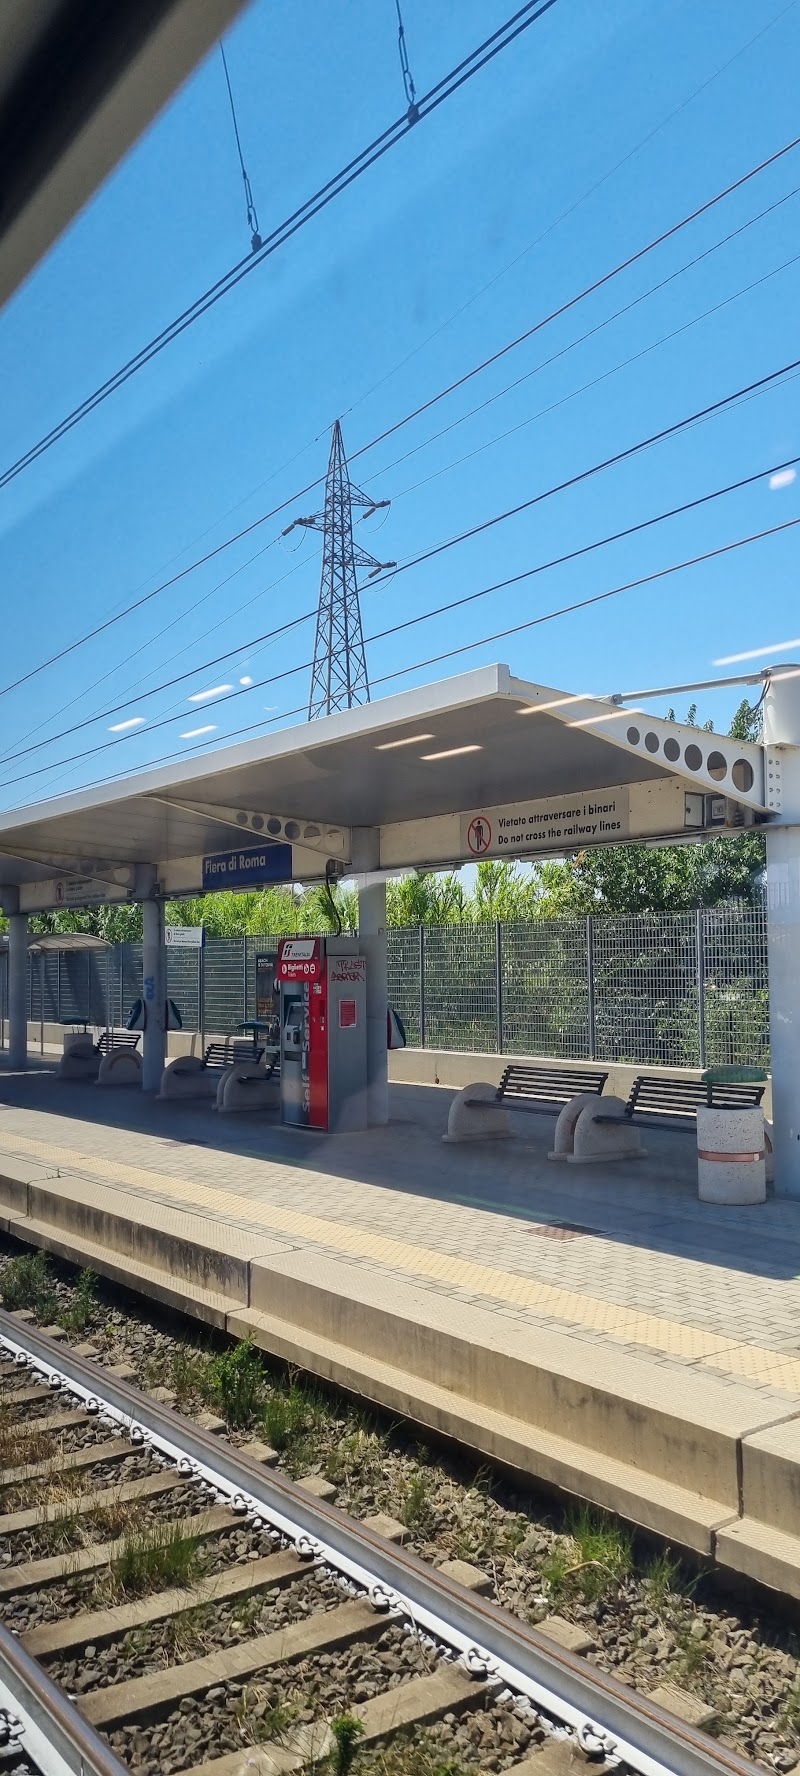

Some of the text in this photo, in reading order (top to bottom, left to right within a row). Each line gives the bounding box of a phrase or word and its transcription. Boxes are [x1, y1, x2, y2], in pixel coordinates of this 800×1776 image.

[498, 816, 526, 828] Vietato
[528, 809, 581, 823] attraversare
[588, 801, 616, 815] binari
[498, 820, 621, 845] Do not cross the railway lines
[205, 854, 266, 875] Fiera di Roma
[287, 963, 304, 972] Biglietti
